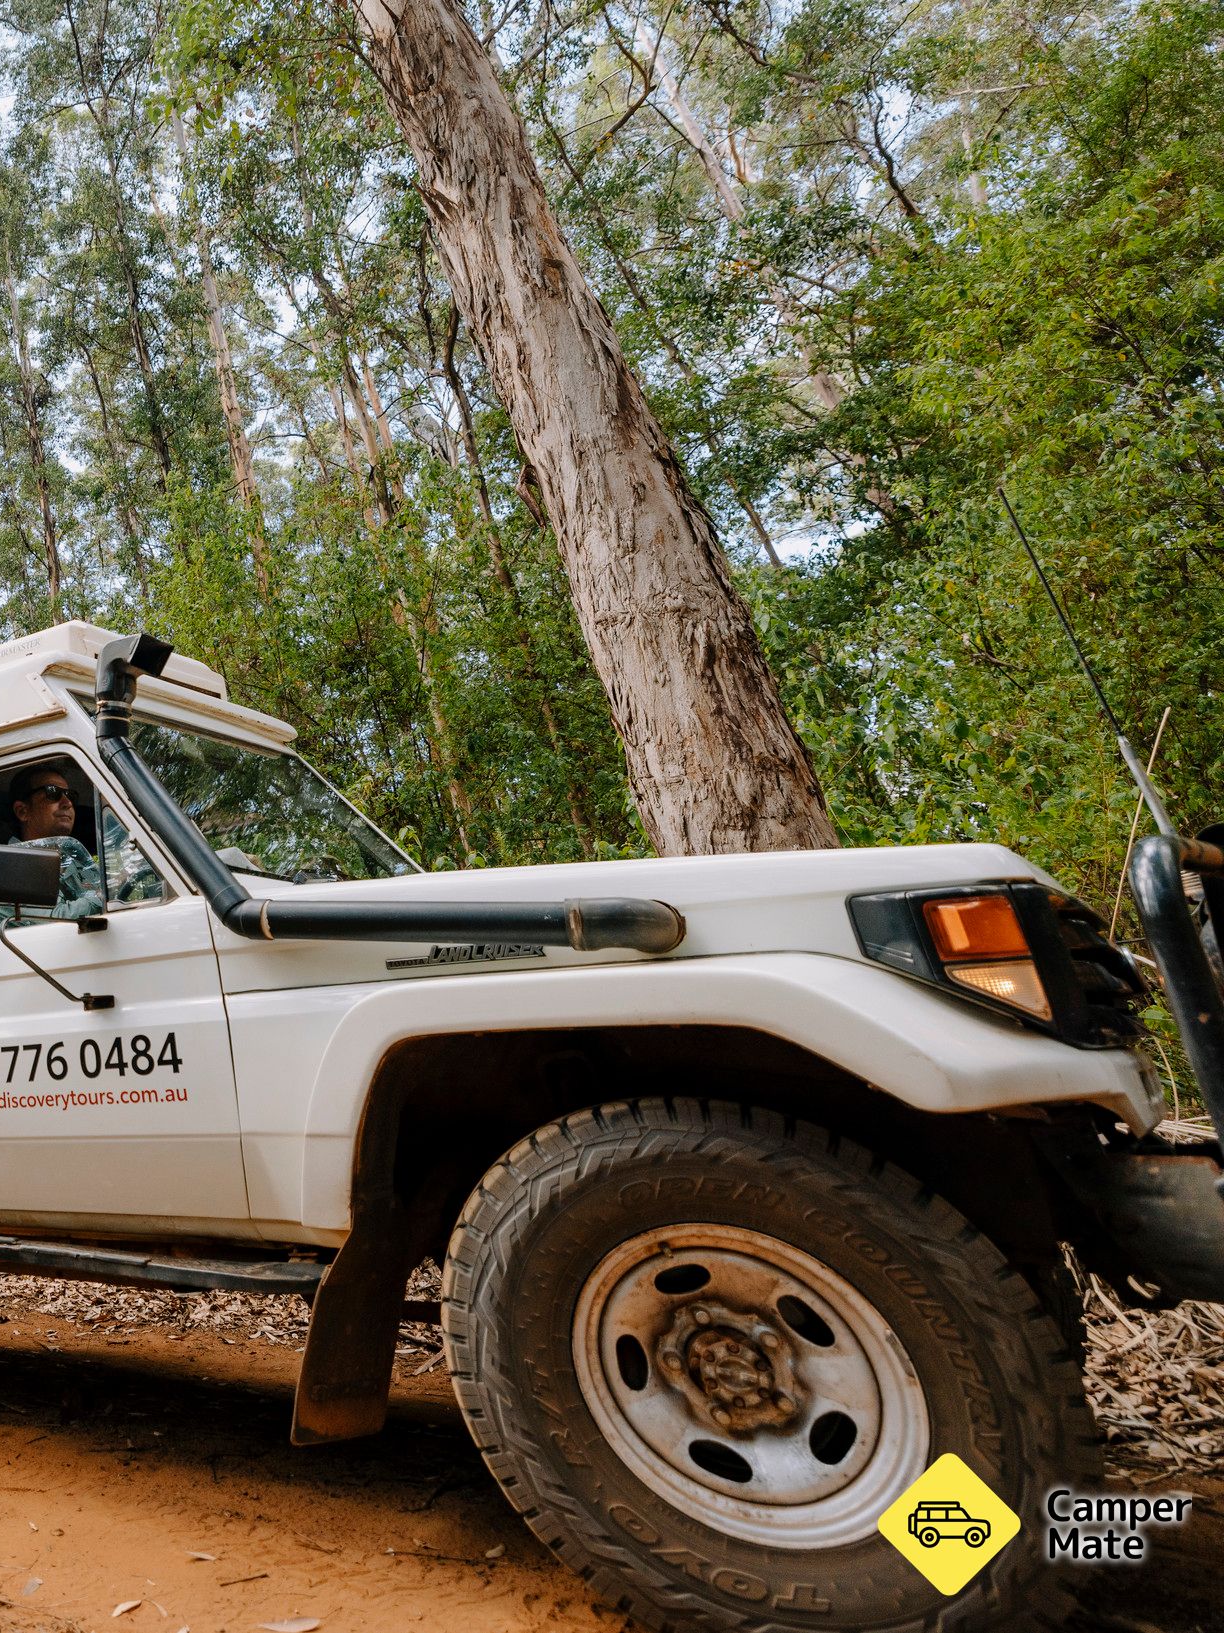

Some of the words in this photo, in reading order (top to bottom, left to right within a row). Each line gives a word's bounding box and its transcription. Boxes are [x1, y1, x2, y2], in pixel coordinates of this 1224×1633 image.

[387, 958, 426, 968] TOYOTA
[79, 1032, 183, 1078] 0484
[618, 1175, 784, 1207] OPEN
[608, 1504, 832, 1613] TOYO
